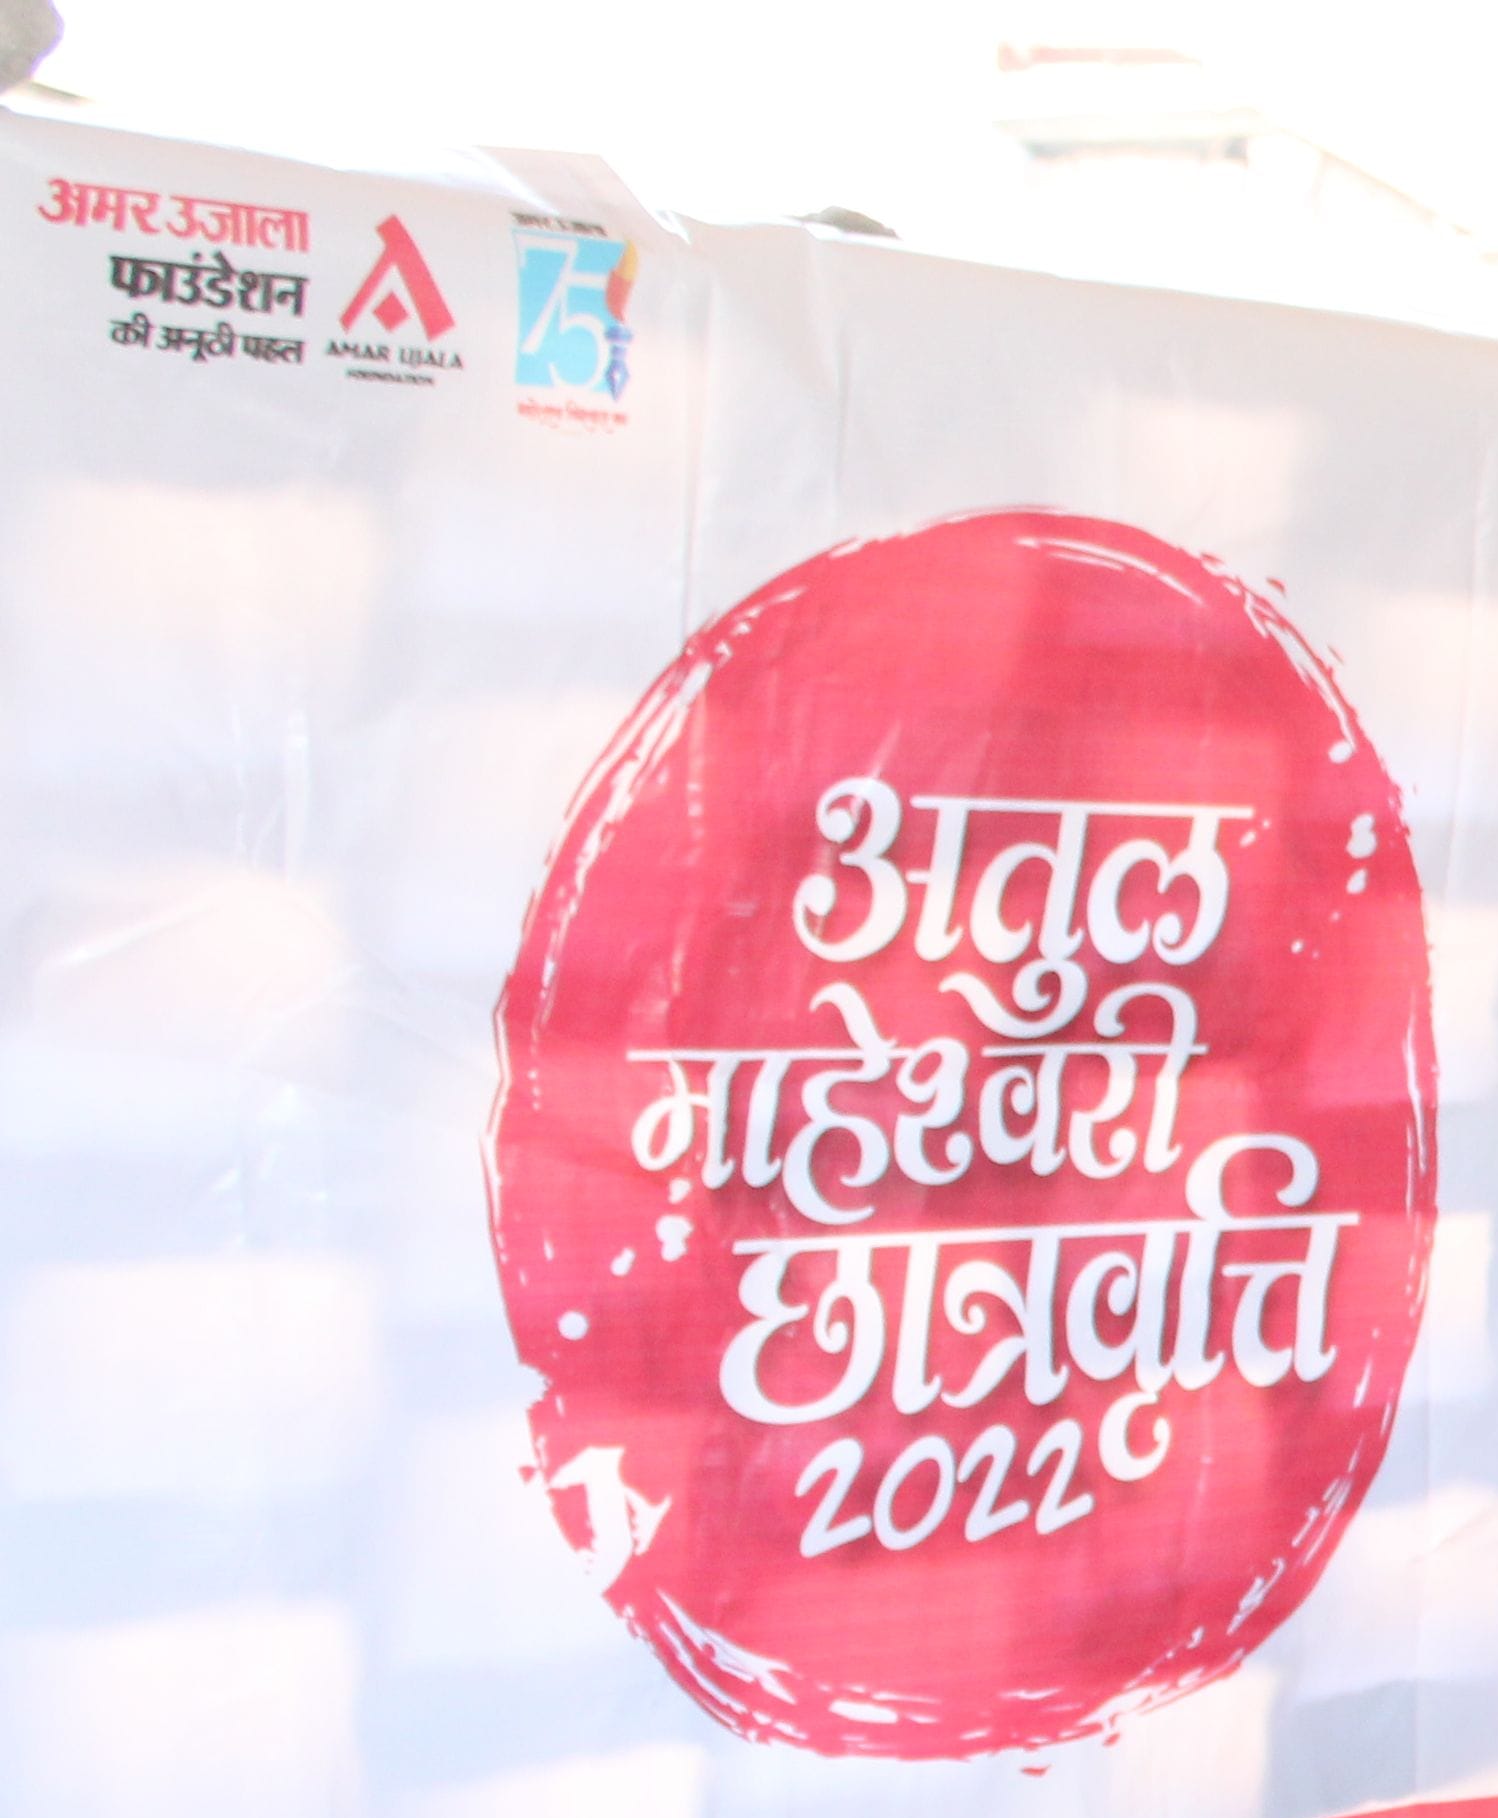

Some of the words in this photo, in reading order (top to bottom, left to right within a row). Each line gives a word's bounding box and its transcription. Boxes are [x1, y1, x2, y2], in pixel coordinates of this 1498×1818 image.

[38, 177, 161, 235] अमर
[166, 195, 309, 251] उजाला
[109, 251, 309, 316] फाउंडेशन
[110, 312, 152, 347] की
[326, 339, 391, 361] AMAR
[398, 346, 464, 369] UJALA
[793, 776, 1254, 1039] अतुल
[626, 981, 1208, 1225] माहेश्वरी
[719, 1133, 1359, 1482] छात्रवृत्ति
[796, 1421, 1093, 1558] 2022
